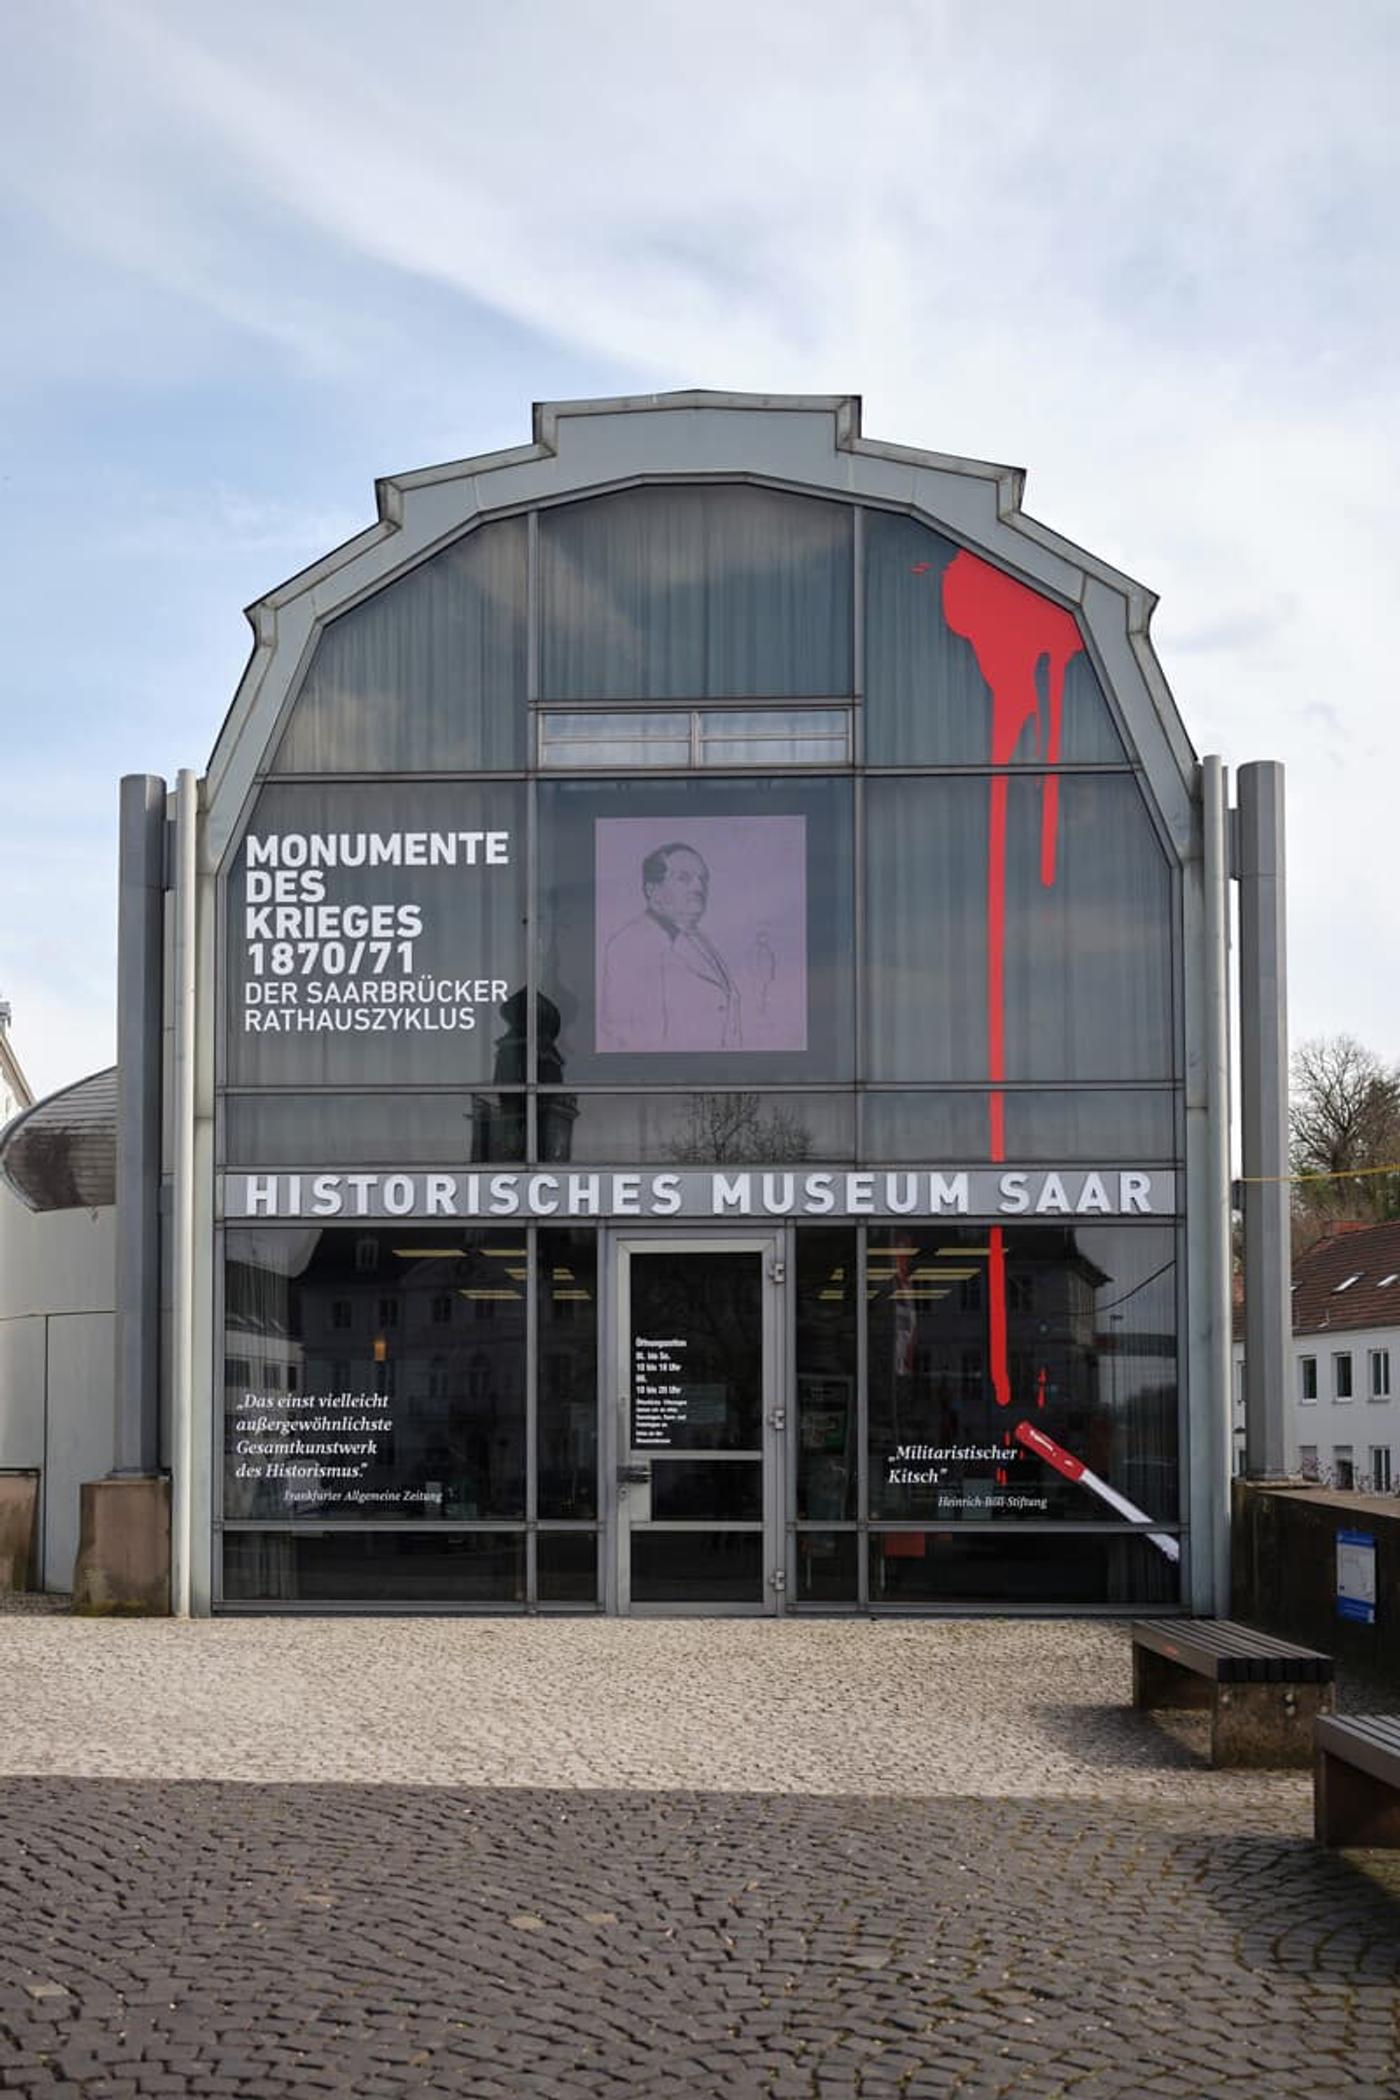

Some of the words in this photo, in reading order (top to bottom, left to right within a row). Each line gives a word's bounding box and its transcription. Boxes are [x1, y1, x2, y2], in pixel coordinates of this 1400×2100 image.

[246, 832, 509, 867] MONUMENTE
[246, 870, 326, 903] DES
[246, 905, 423, 939] KRIEGES
[248, 941, 414, 975] 1870/71
[246, 982, 298, 1004] DER
[307, 974, 509, 1003] SAARBRÜCKER
[245, 1007, 476, 1032] RATHAUSZYKLUS
[245, 1174, 683, 1215] HISTORISCHES
[712, 1172, 969, 1214] MUSEUM
[999, 1171, 1152, 1214] SAAR
[277, 1393, 315, 1408] einst
[319, 1393, 389, 1408] vielleicht
[236, 1416, 392, 1435] außergewöhnlichste
[236, 1440, 377, 1454] Gesamtkunstwerk
[236, 1463, 262, 1478] des
[284, 1490, 341, 1503] Frankfurter
[345, 1489, 400, 1504] Allgemeine
[403, 1490, 443, 1504] Zeitung
